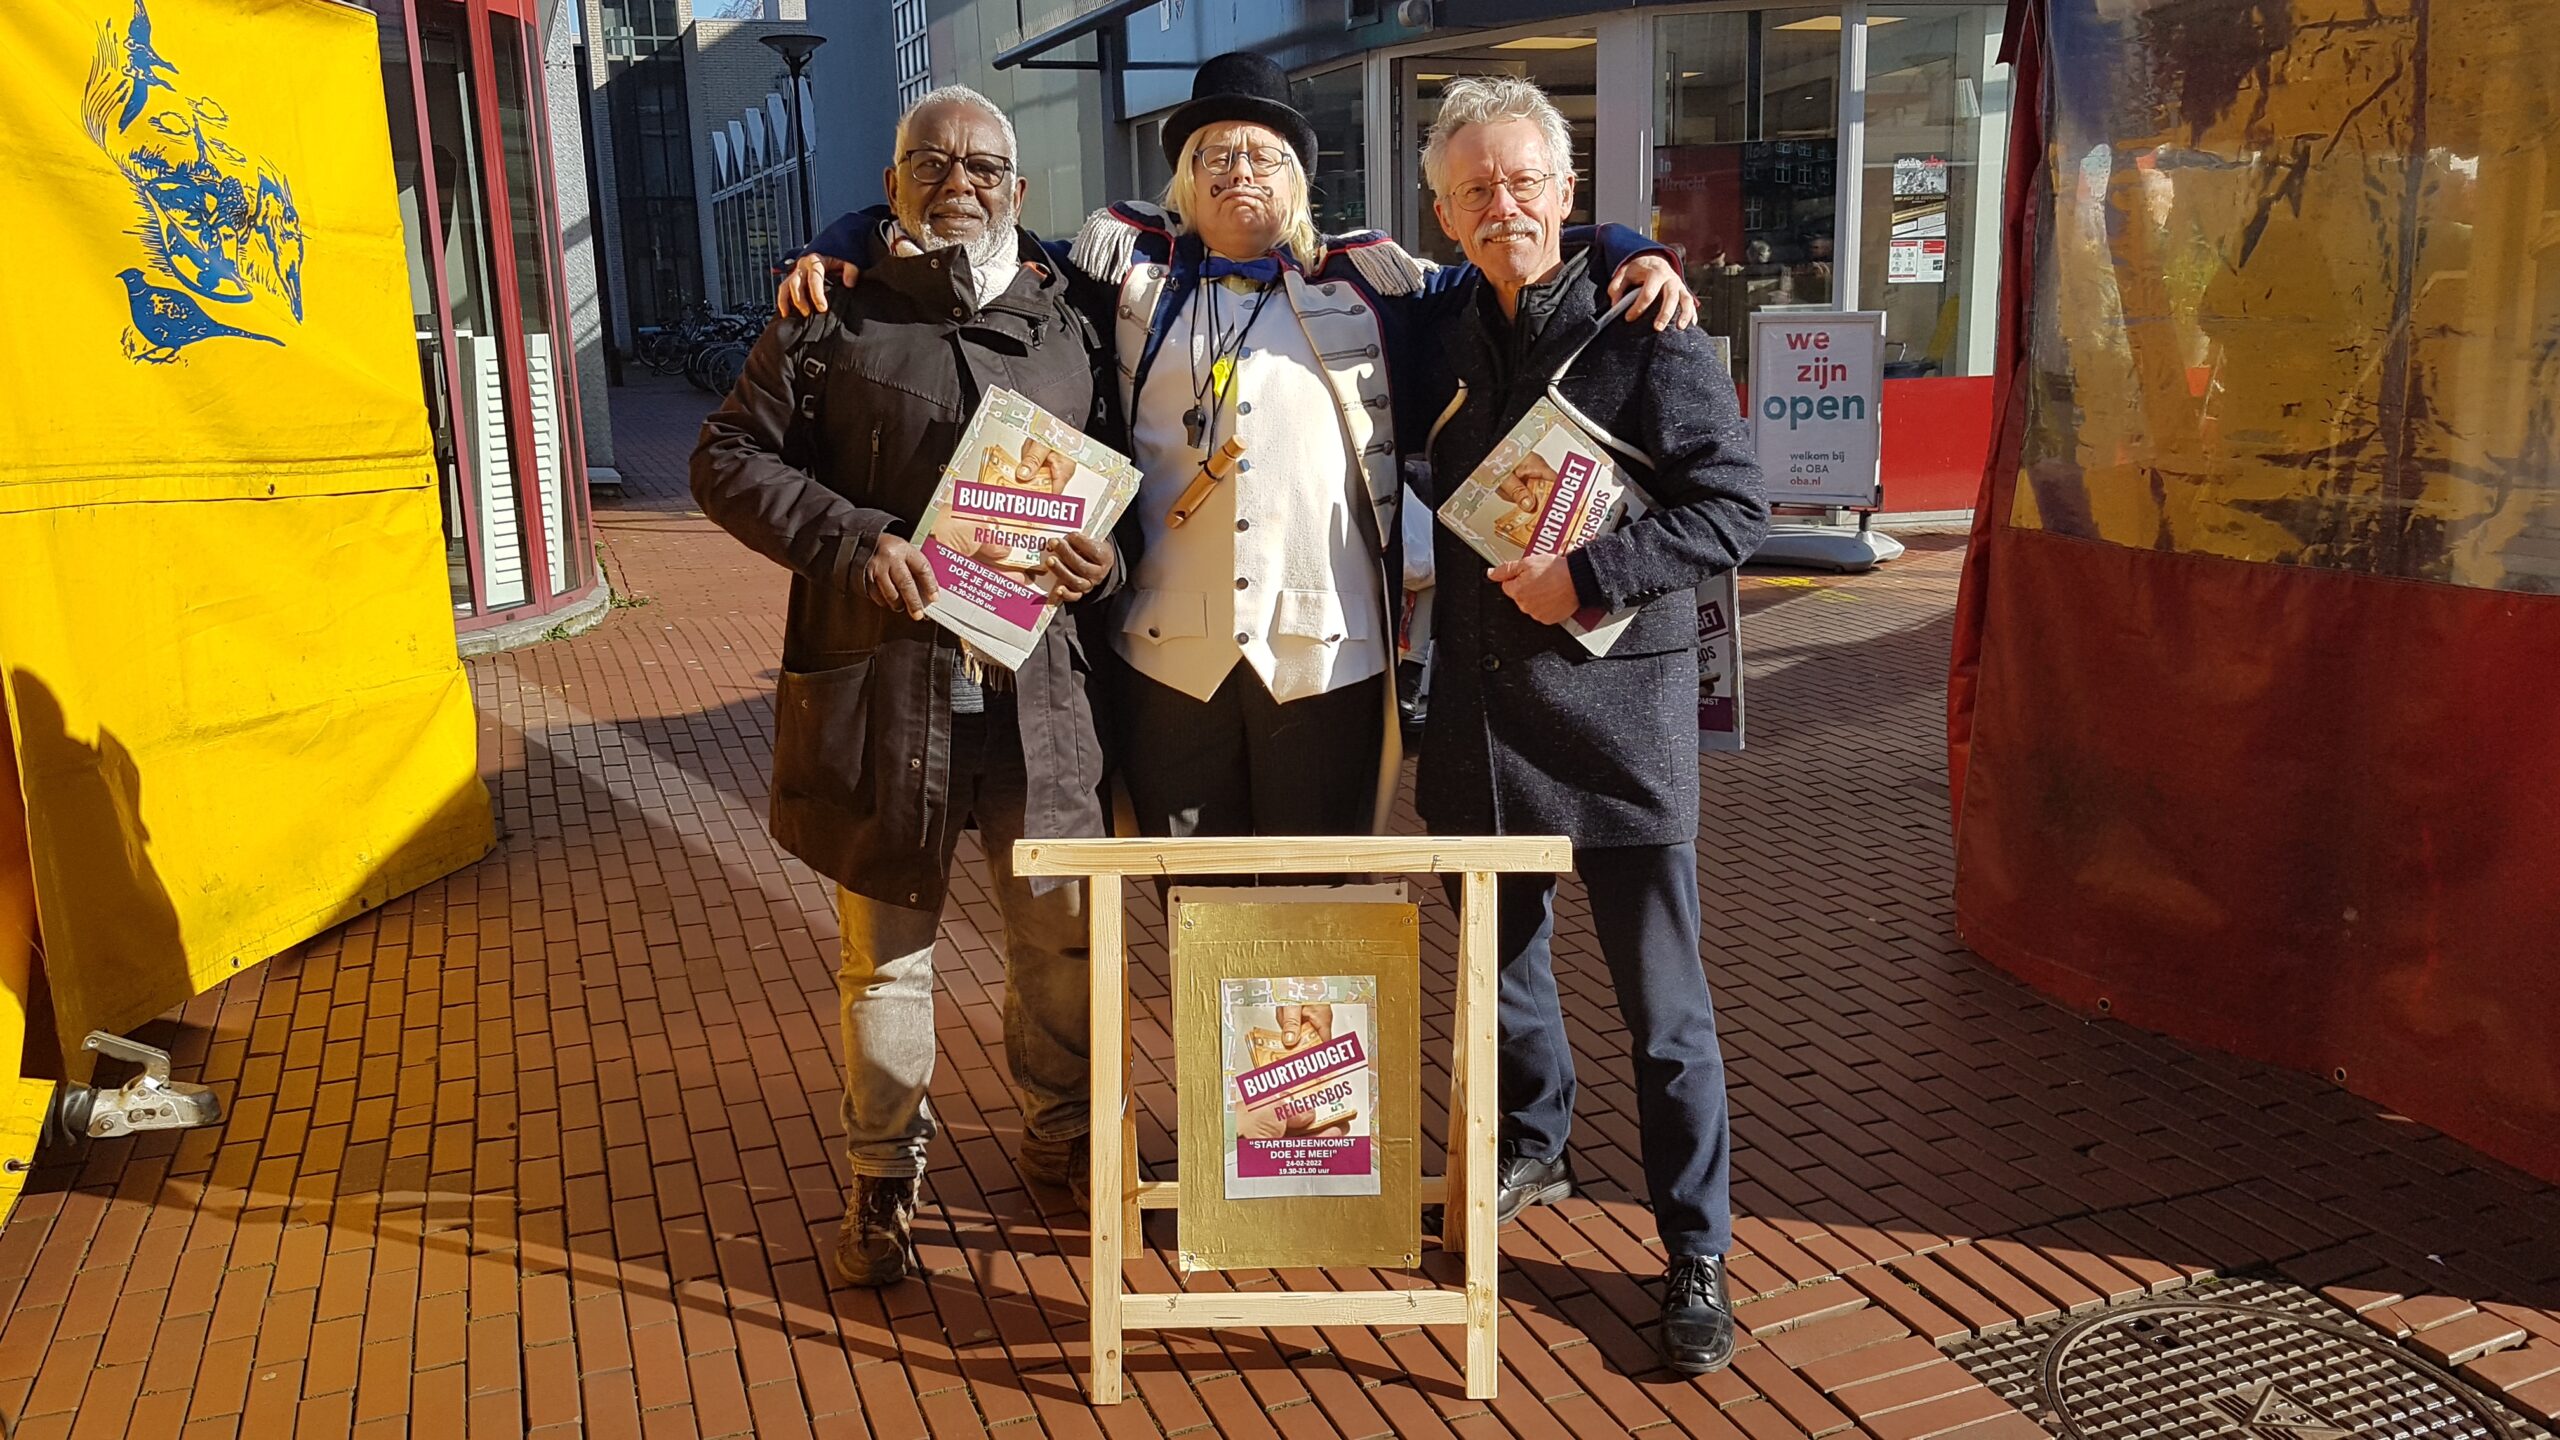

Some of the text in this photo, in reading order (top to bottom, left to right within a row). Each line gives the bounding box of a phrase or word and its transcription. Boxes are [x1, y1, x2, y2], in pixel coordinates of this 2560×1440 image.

[1786, 331, 1830, 350] we
[1797, 356, 1847, 390] zijn
[1763, 395, 1865, 430] open
[1790, 451, 1845, 463] welkom bij
[1790, 464, 1829, 473] de OBA
[1790, 476, 1821, 486] oba.nl
[958, 486, 1079, 522] BUURTBUDGET
[948, 564, 969, 580] DOE
[970, 575, 982, 587] JE
[959, 580, 994, 602] 24-02-2022
[984, 602, 997, 612] uur
[1243, 1039, 1356, 1098] BUURTBUDGET
[1274, 1080, 1353, 1122] REIGERSBOS
[1270, 1150, 1292, 1160] DOE
[1294, 1150, 1306, 1159] JE
[1279, 1167, 1317, 1175] 19.30-21.00
